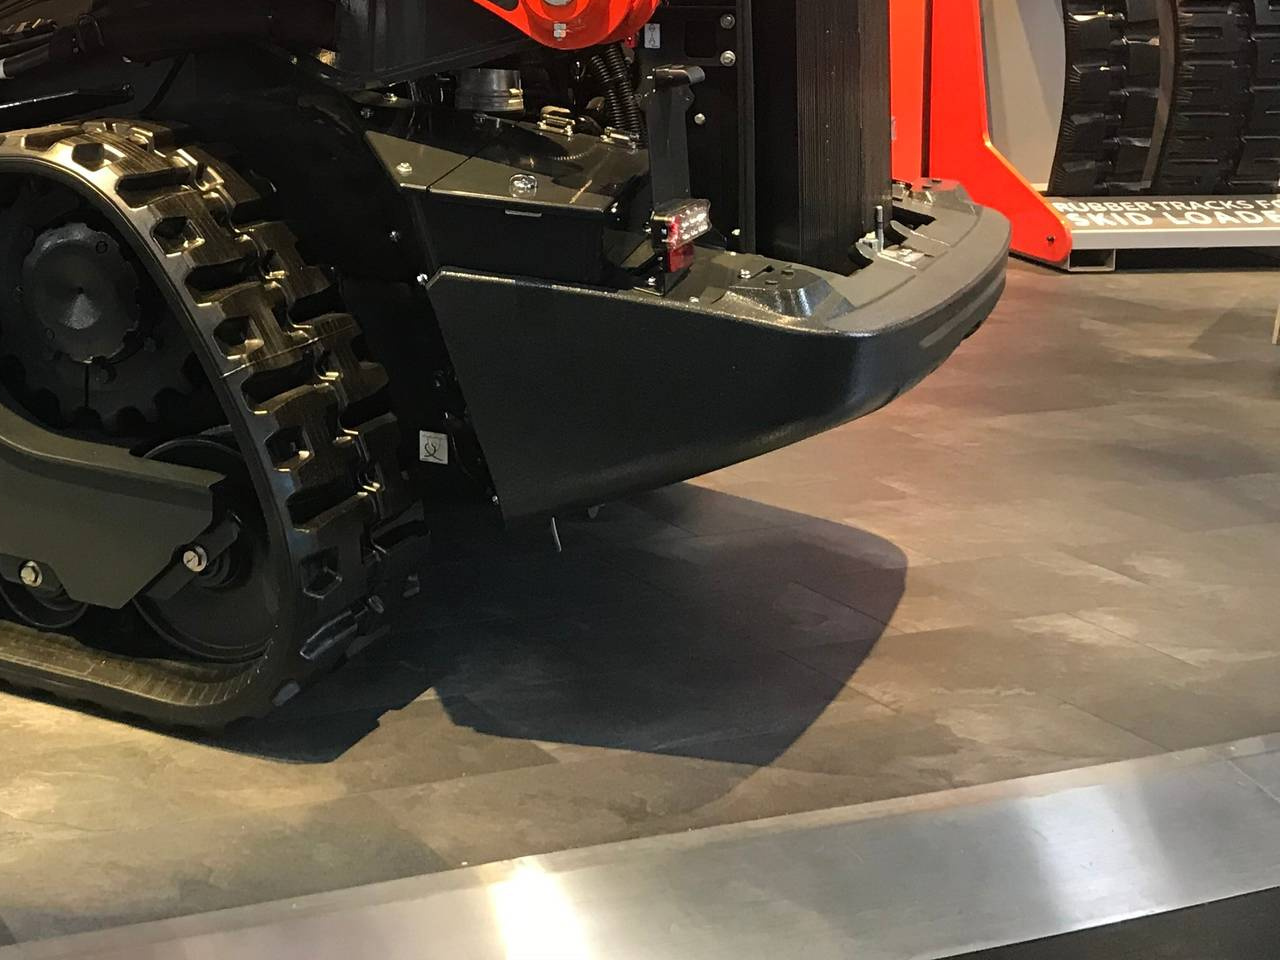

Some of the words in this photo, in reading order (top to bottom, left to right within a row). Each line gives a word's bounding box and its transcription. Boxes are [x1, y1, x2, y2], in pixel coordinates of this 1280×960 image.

[1052, 199, 1155, 213] RUBBER
[1153, 199, 1255, 212] TRACKS
[1066, 210, 1154, 227] SKID
